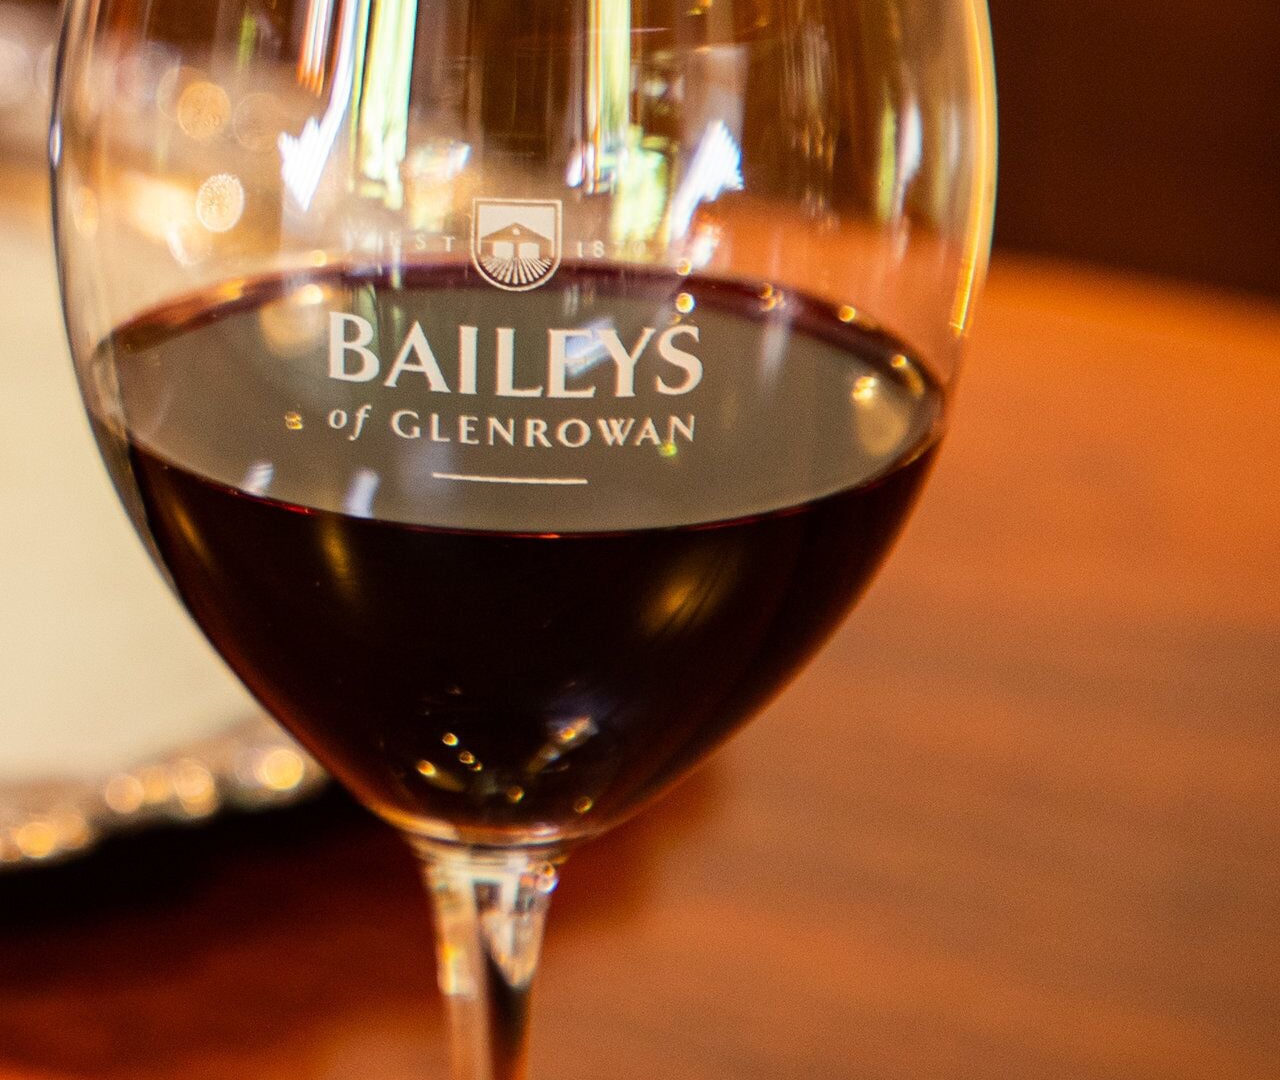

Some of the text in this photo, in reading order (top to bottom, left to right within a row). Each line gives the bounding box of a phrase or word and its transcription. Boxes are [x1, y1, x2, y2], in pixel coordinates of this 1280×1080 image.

[327, 311, 704, 399] BAILEYS
[328, 404, 696, 449] of GLENROWAN
